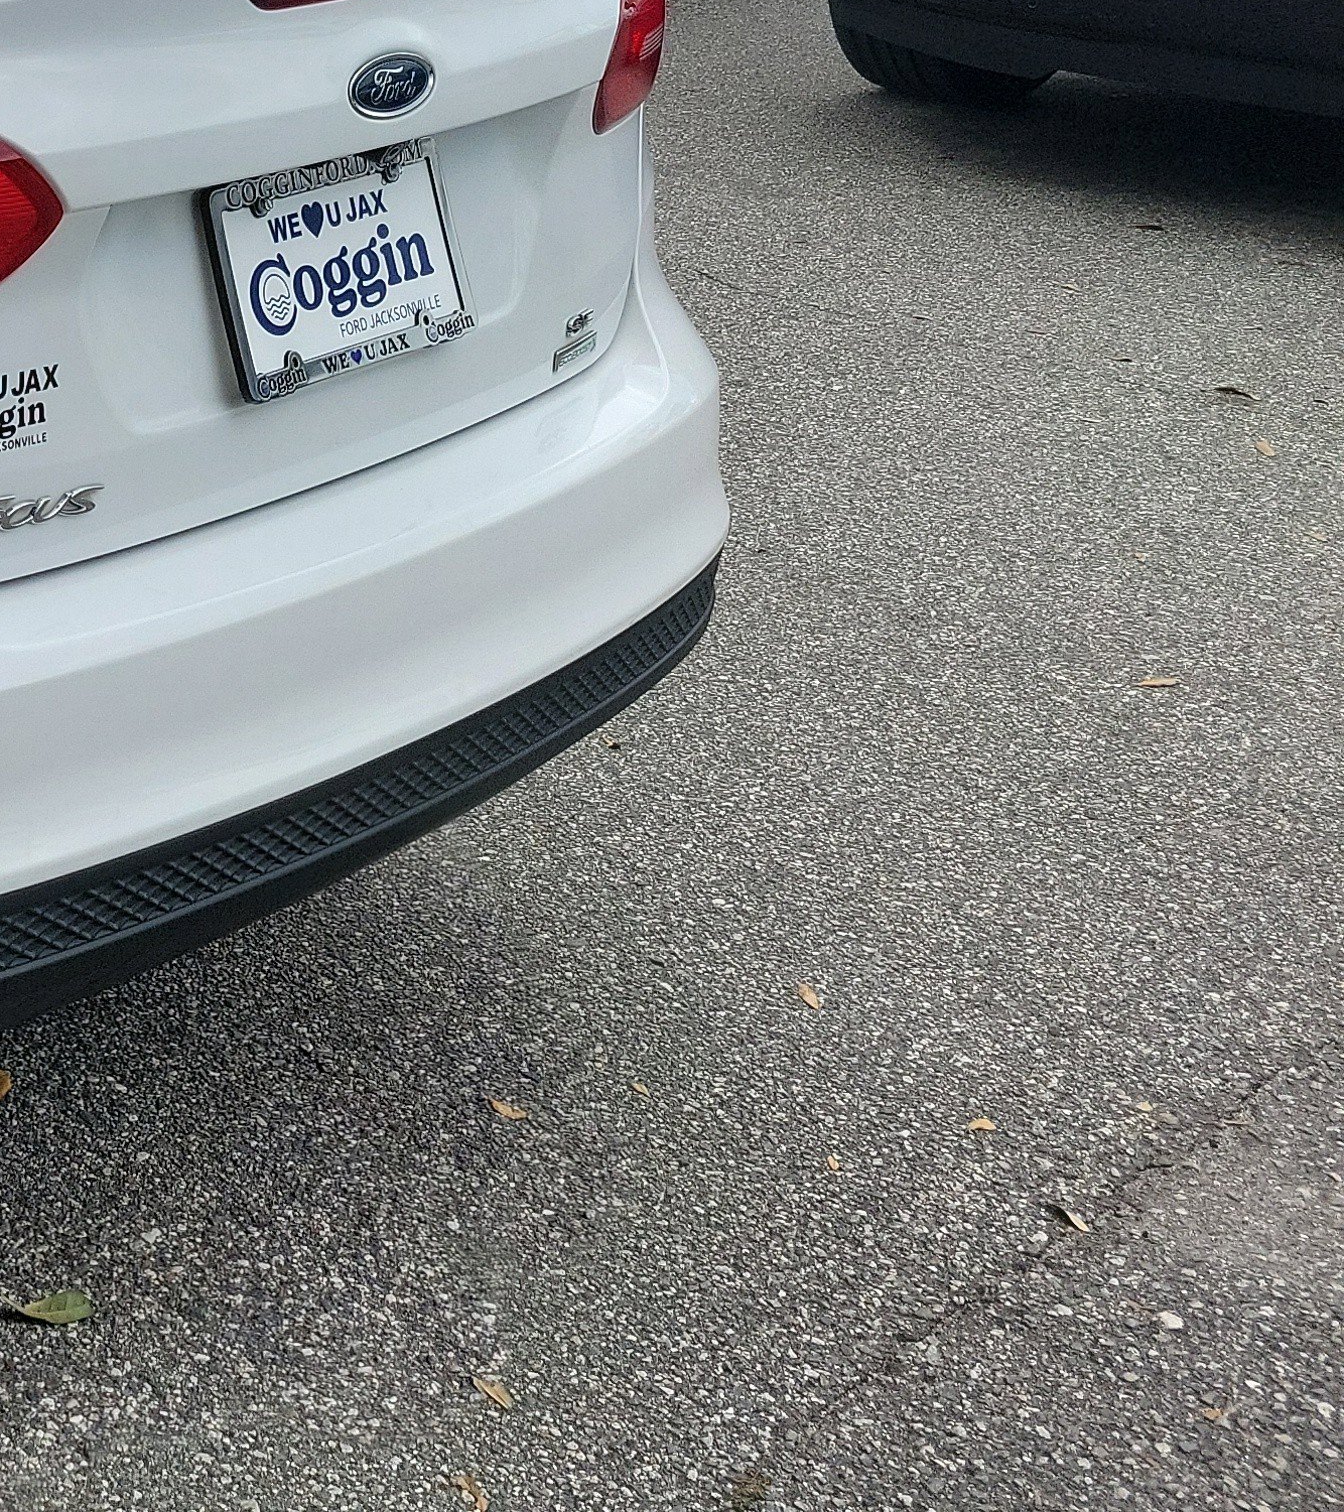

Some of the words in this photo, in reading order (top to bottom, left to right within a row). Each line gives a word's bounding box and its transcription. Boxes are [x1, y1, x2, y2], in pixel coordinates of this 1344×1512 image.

[370, 65, 417, 105] Ford
[267, 212, 303, 244] WE
[325, 200, 344, 228] U
[346, 189, 388, 223] JAX
[249, 223, 434, 337] Coggin
[340, 316, 368, 337] FORD
[369, 294, 442, 329] JACKSONVILLE
[426, 313, 475, 343] Coggin
[322, 354, 350, 374] WE
[363, 346, 376, 360] U
[379, 334, 410, 356] JAX
[11, 363, 59, 396] JAX
[257, 367, 307, 399] Coggin
